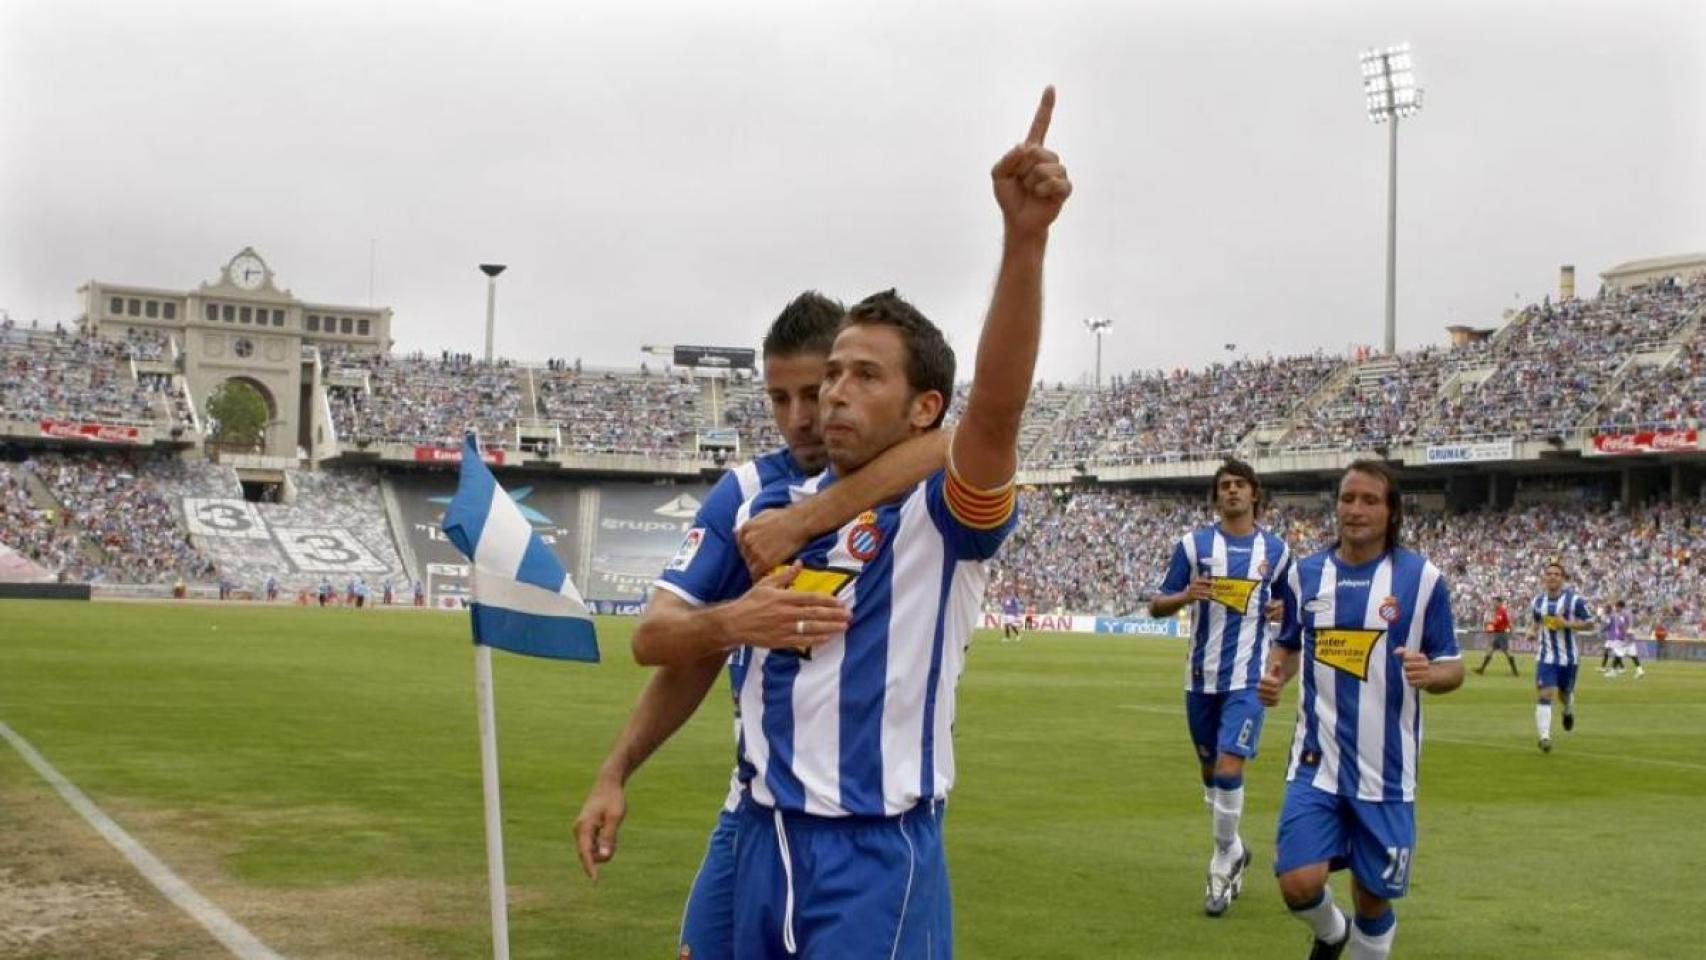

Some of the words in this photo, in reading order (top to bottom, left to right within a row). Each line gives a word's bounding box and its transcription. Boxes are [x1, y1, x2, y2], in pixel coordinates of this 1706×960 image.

[199, 505, 253, 531] 3
[601, 519, 676, 532] grupo
[297, 534, 361, 564] 3
